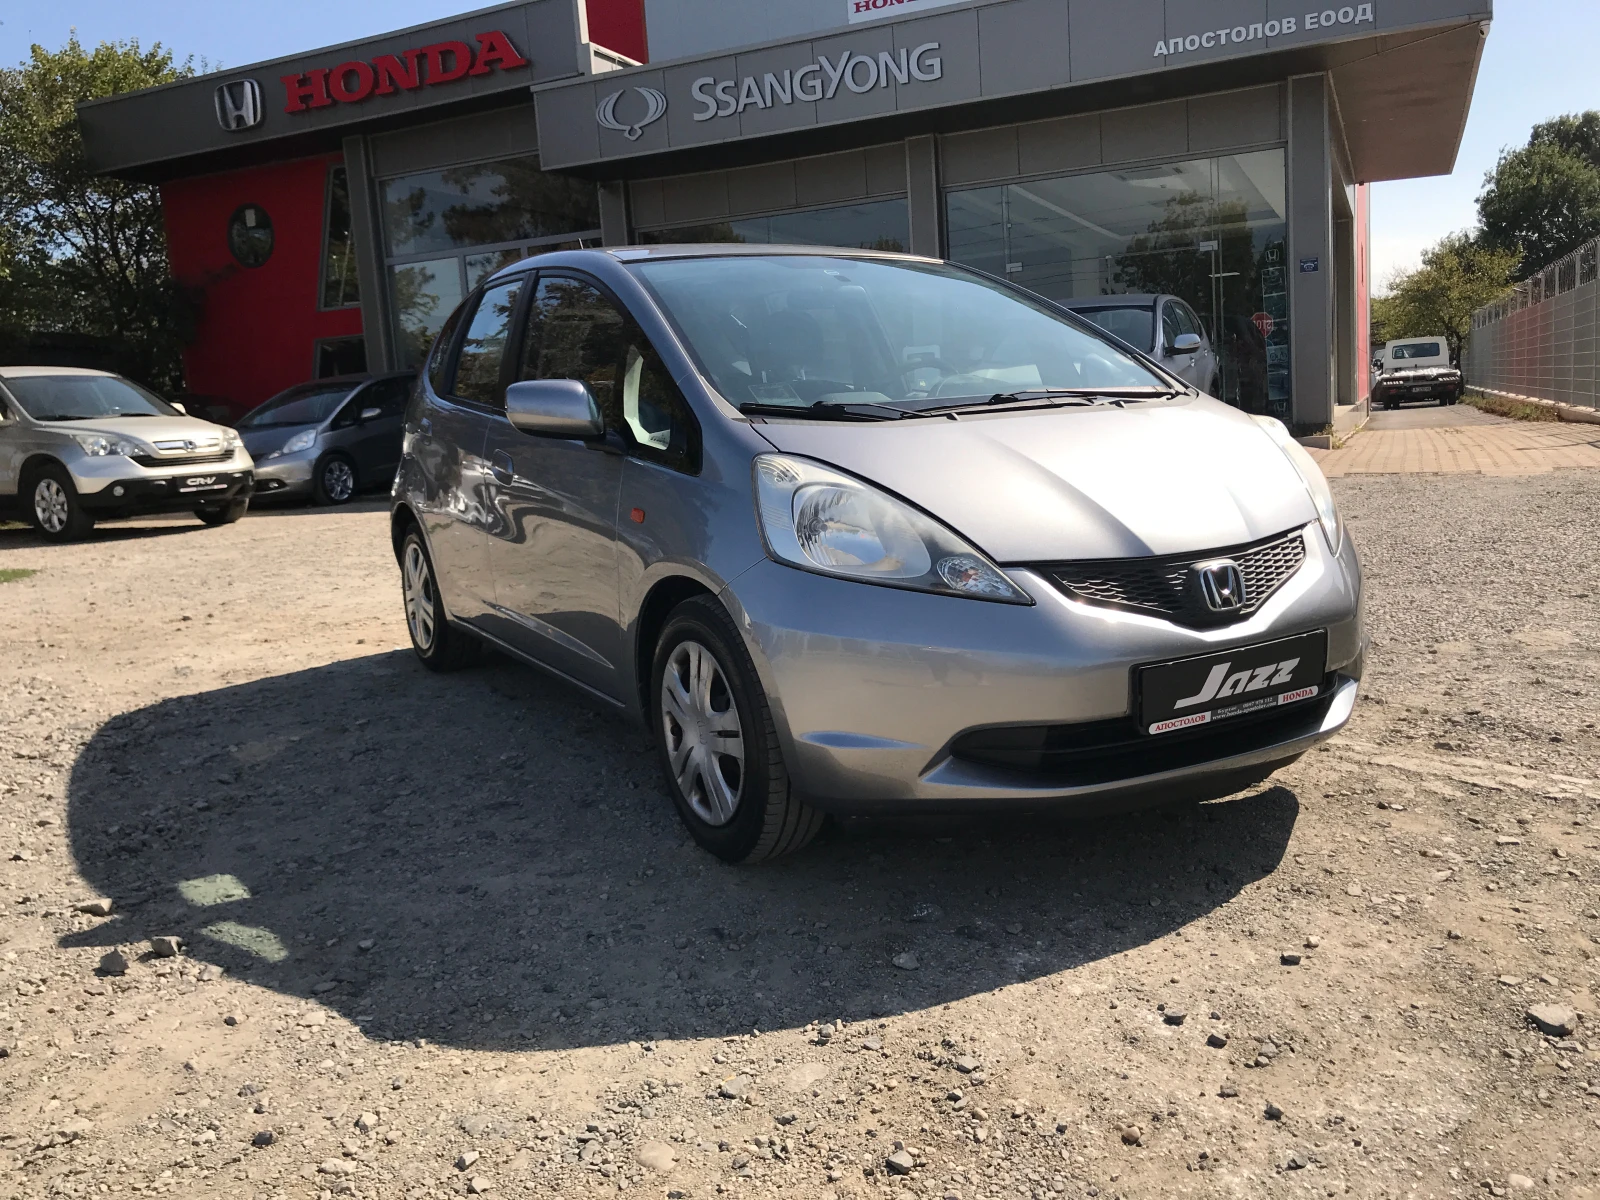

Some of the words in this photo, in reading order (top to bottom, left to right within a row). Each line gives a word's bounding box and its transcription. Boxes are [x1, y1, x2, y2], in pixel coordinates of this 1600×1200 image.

[1153, 17, 1297, 57] АПОСТОЛОВ
[1304, 3, 1373, 30] ЕООД
[280, 30, 527, 113] HONDA
[186, 476, 217, 486] CR-V
[1174, 657, 1300, 709] Jazz
[1282, 688, 1314, 704] HONDA
[1155, 714, 1206, 732] АПОСТОЛОВ
